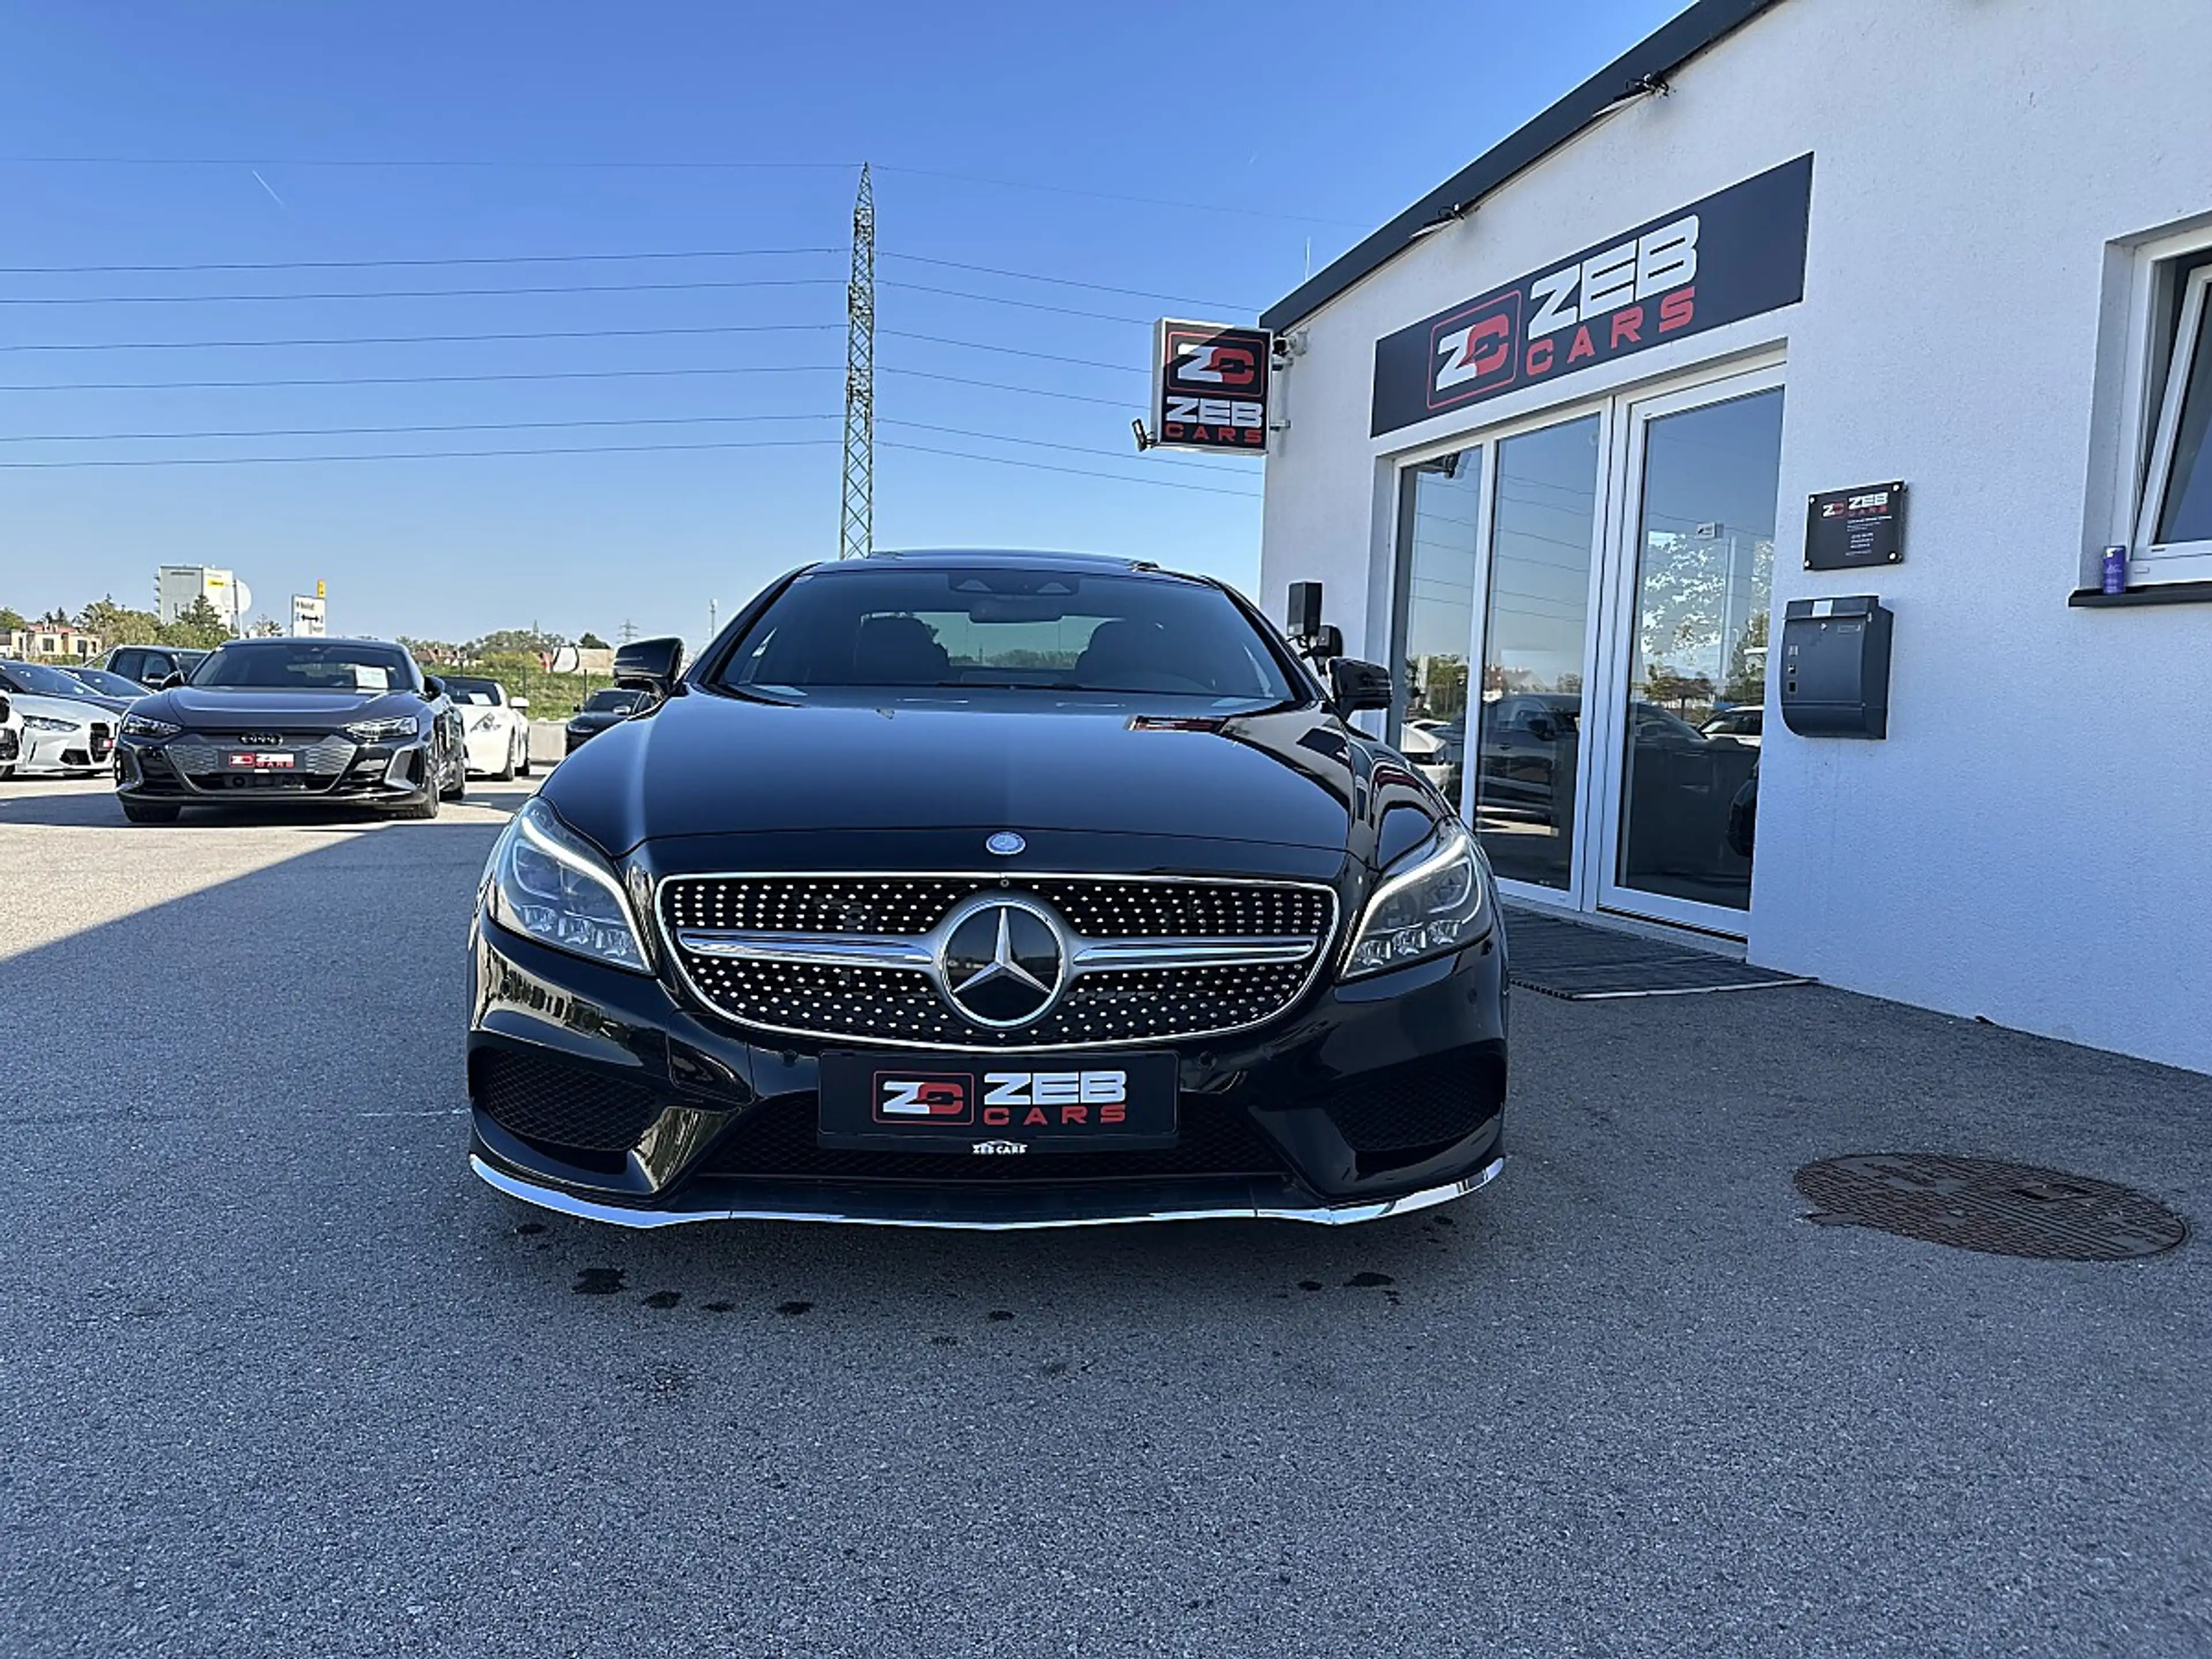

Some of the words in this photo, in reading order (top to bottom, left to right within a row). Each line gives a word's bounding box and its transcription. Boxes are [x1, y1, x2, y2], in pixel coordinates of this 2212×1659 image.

[1528, 214, 1699, 340] ZEB
[1526, 286, 1695, 376] CARS
[1166, 396, 1263, 428] ZEB
[1165, 423, 1262, 443] CARS
[1849, 493, 1888, 509] ZEB
[984, 1070, 1127, 1105] ZEB
[983, 1104, 1127, 1126] CARS
